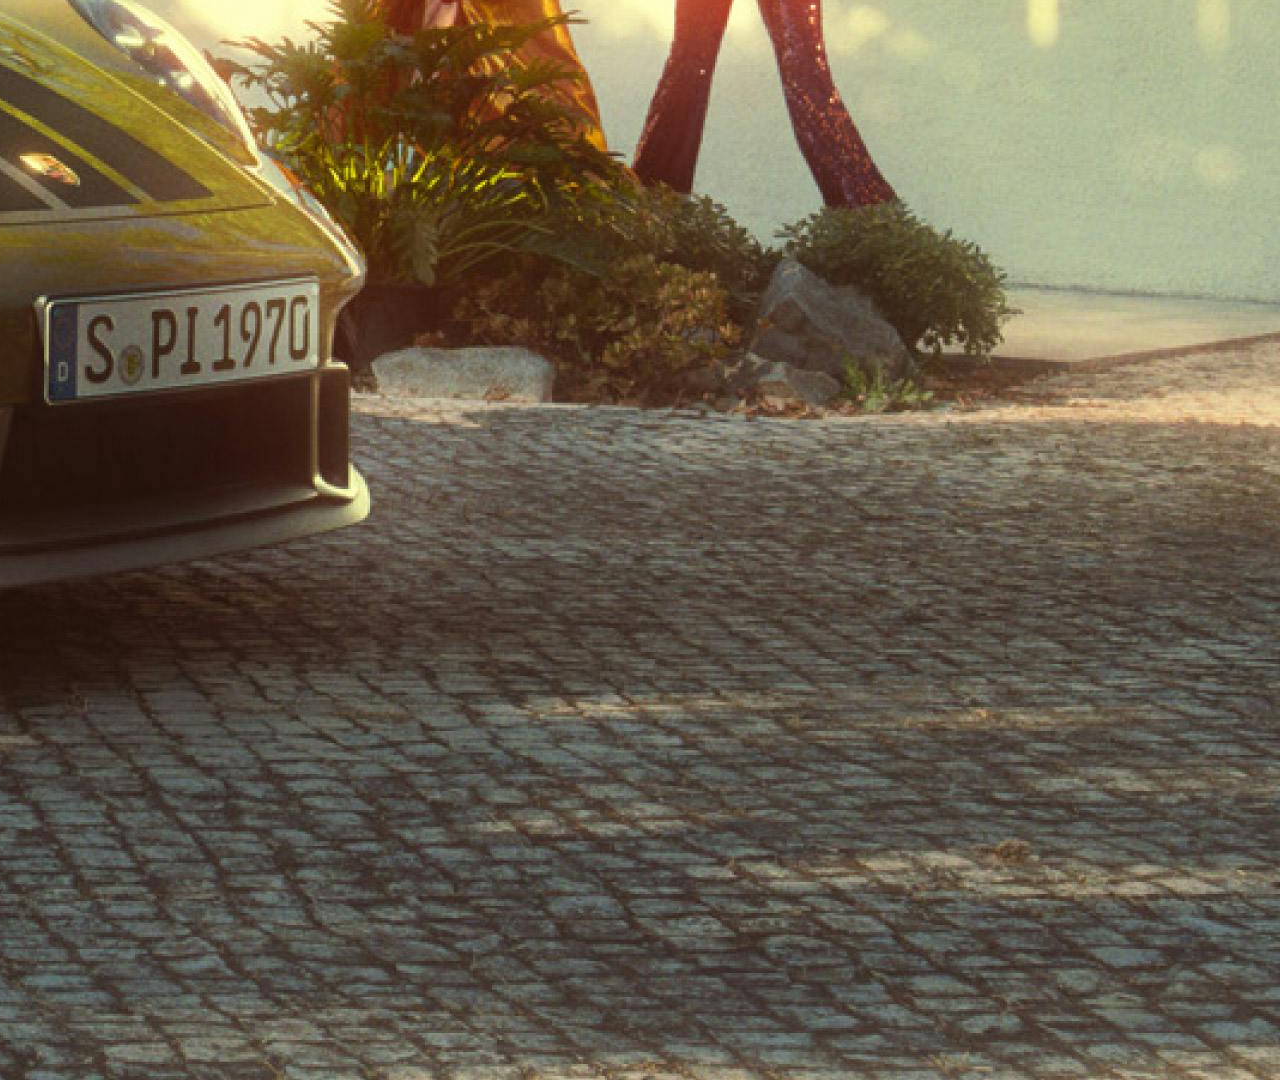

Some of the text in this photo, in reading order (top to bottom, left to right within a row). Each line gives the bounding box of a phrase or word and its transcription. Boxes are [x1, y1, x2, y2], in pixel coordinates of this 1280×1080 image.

[84, 314, 115, 384] S
[212, 294, 310, 371] 1970
[56, 360, 69, 382] D
